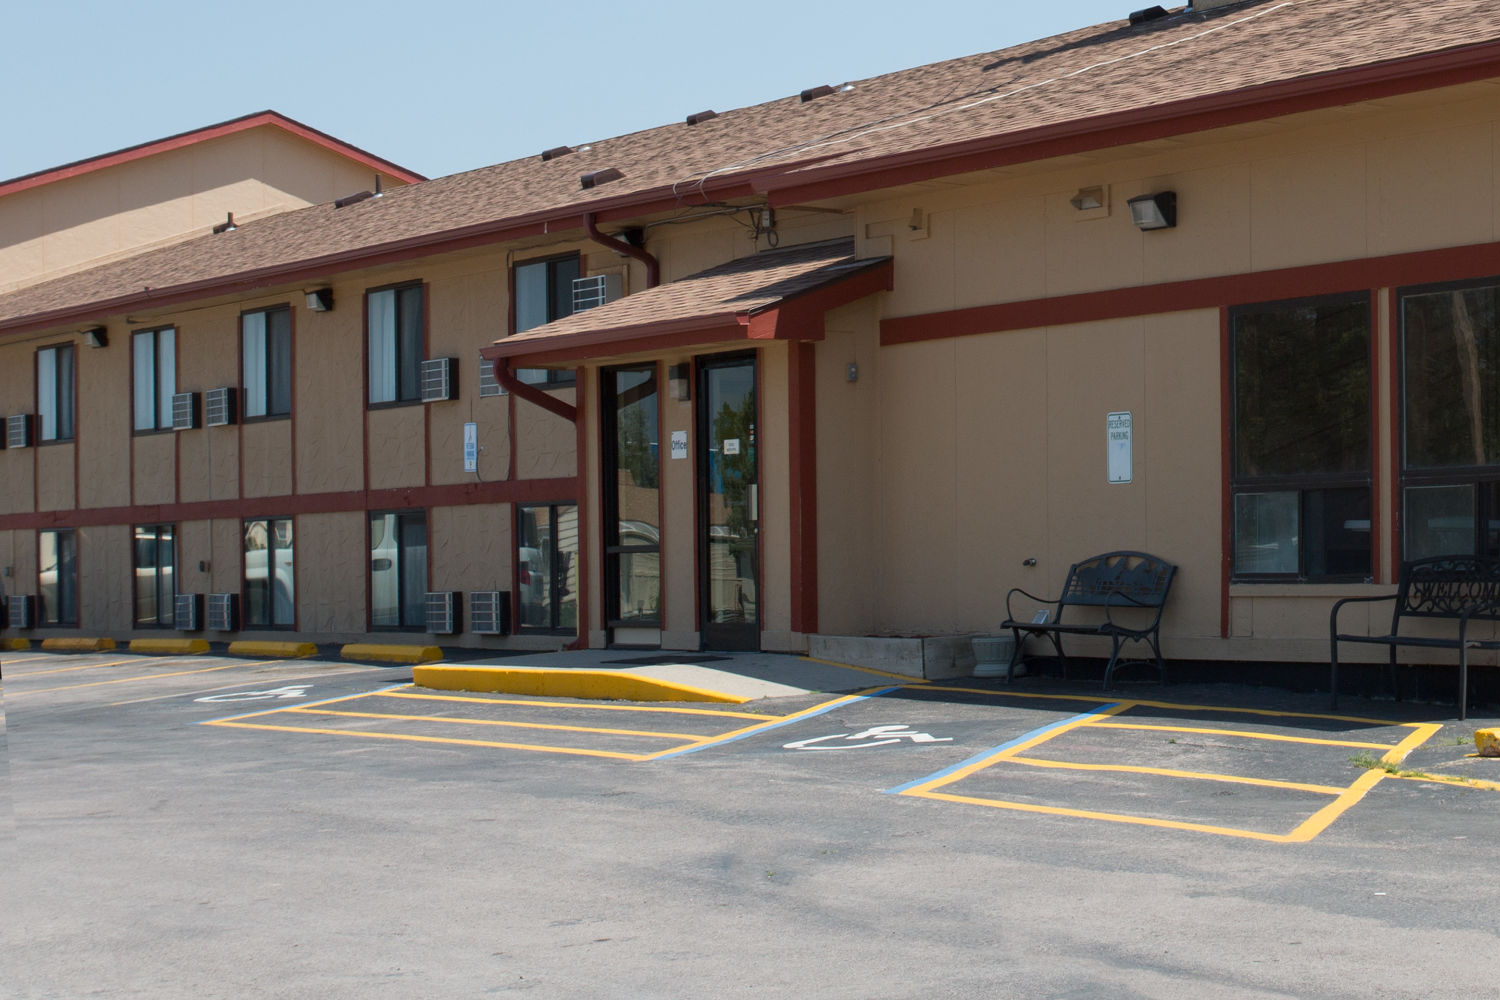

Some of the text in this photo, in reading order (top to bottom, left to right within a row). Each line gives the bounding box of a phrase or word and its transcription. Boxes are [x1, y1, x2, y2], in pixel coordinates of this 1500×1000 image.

[1108, 419, 1130, 429] RESERVED
[1110, 431, 1129, 440] PARKING
[671, 440, 687, 450] Office
